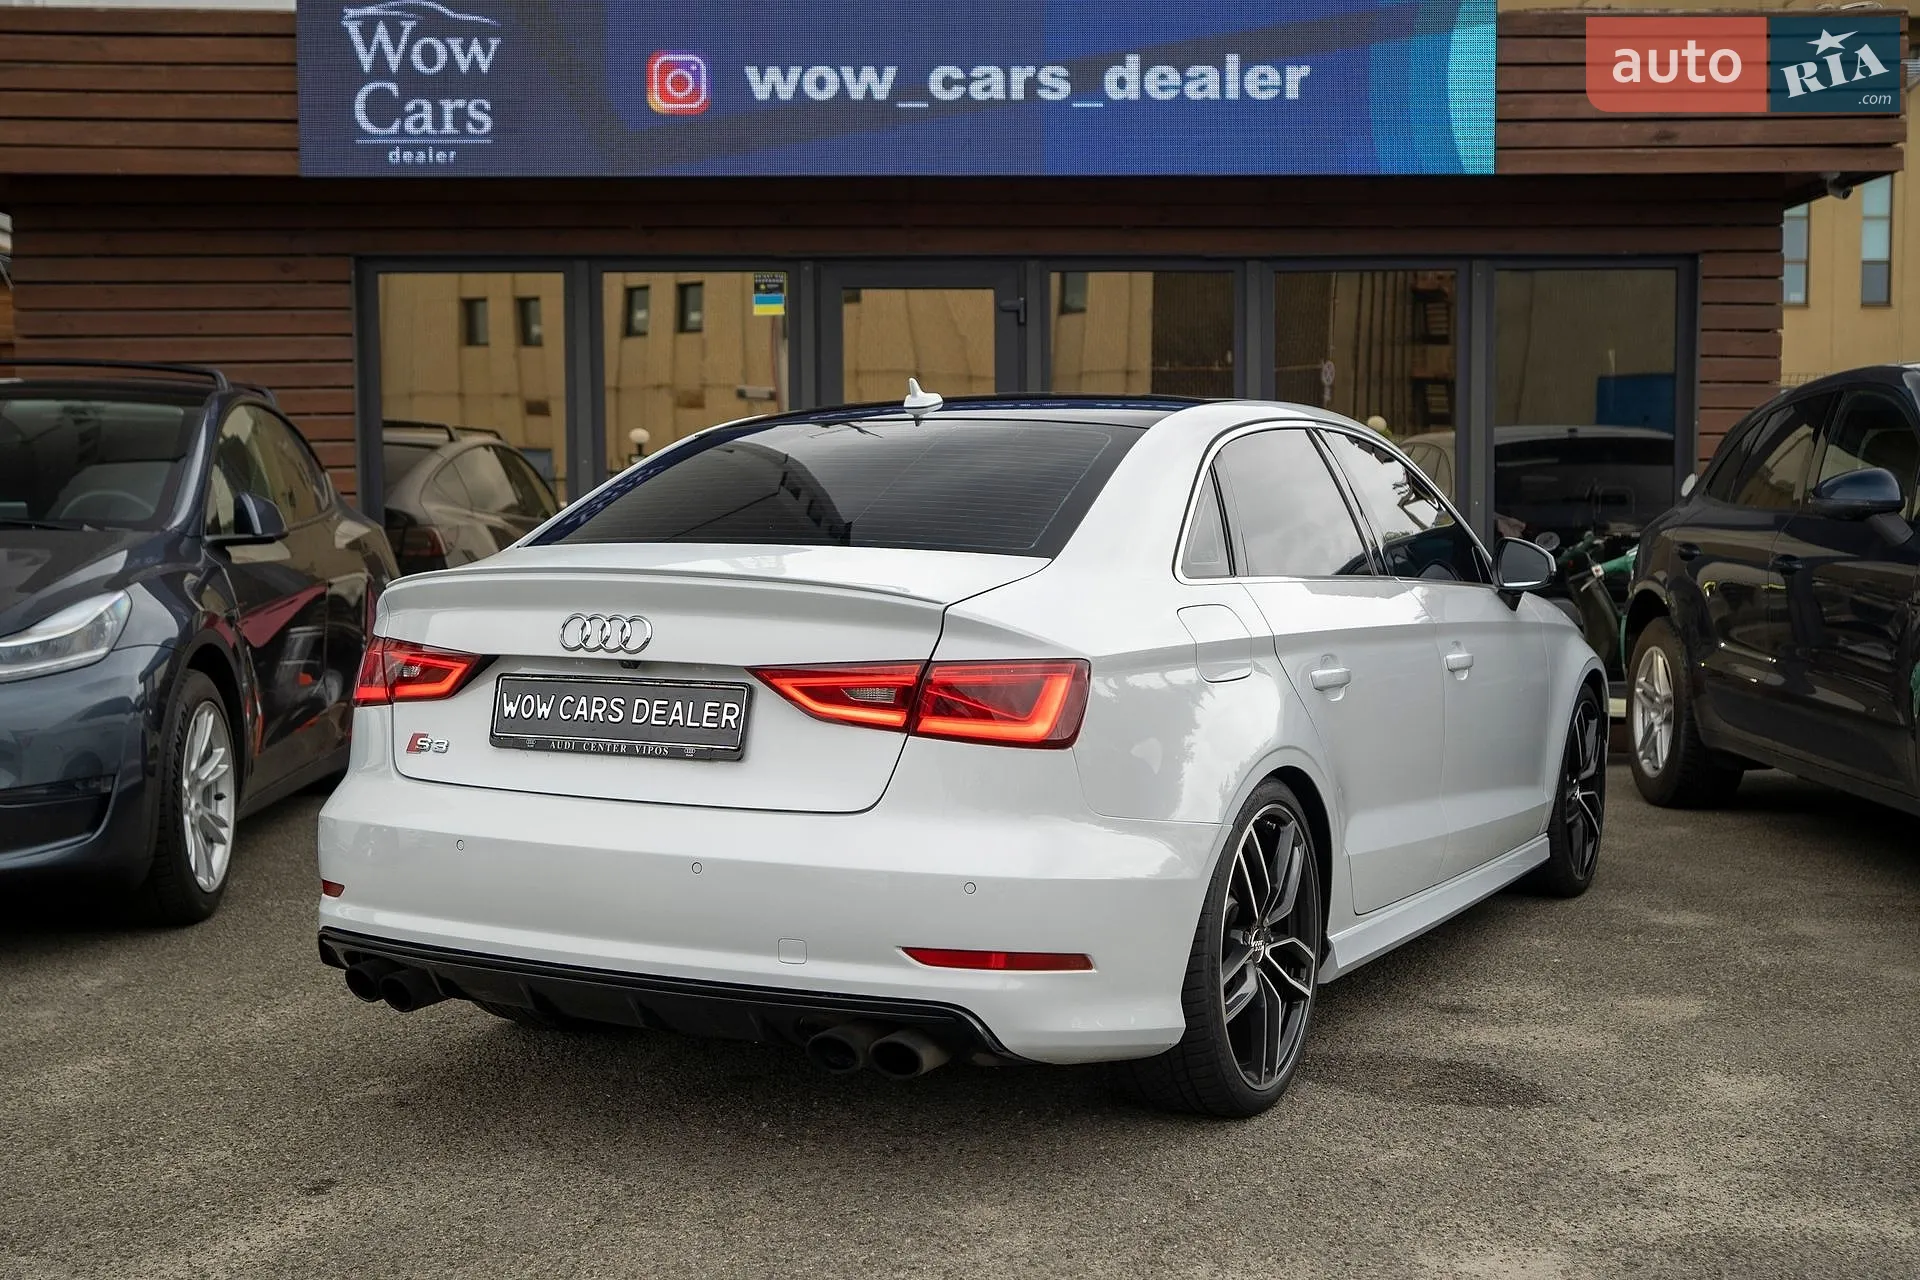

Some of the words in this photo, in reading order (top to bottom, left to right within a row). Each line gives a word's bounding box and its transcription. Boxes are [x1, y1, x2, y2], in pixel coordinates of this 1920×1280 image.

[744, 53, 1312, 108] wow_cars_dealer
[354, 82, 493, 135] Cars
[388, 146, 457, 164] dealer
[503, 692, 555, 720] WOW
[558, 695, 625, 723] CARS
[631, 699, 741, 730] DEALER
[414, 736, 449, 753] S3
[549, 740, 576, 751] AUDI
[583, 742, 628, 753] CENTER
[635, 745, 670, 756] VIPOS
